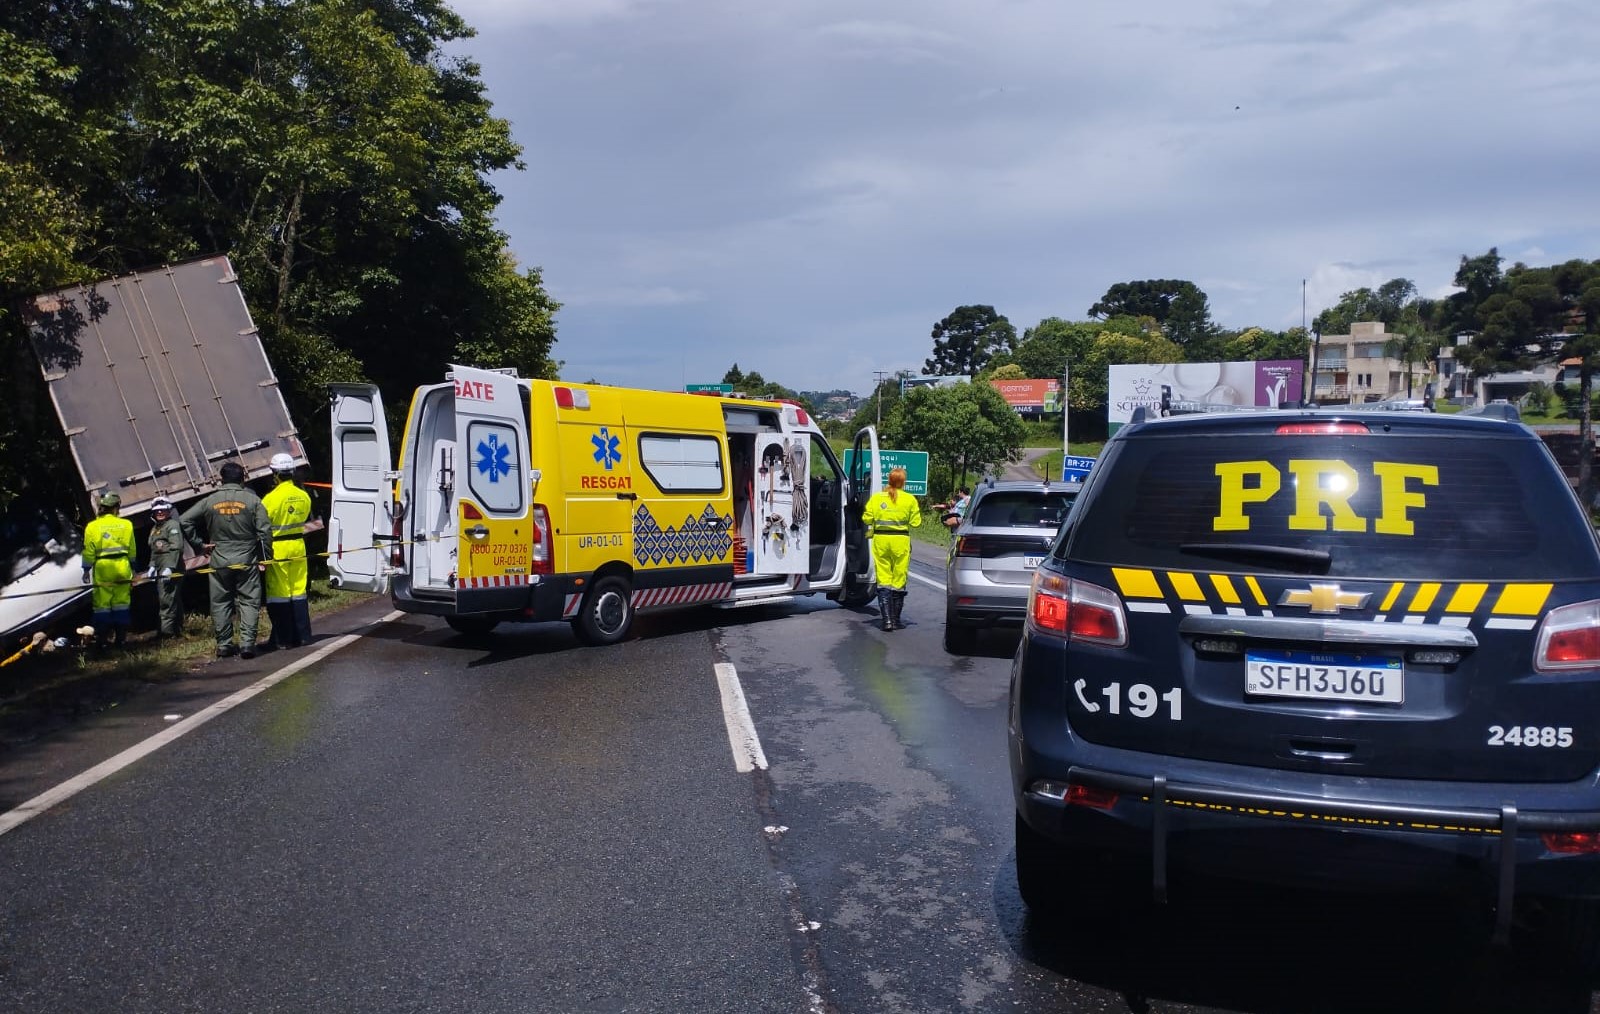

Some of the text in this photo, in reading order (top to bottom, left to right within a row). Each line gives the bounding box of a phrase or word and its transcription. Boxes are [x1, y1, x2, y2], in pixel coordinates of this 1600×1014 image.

[1067, 459, 1095, 468] BR-277
[1213, 459, 1439, 536] PRF
[579, 534, 624, 548] UR-01-01
[493, 544, 507, 554] 277
[509, 544, 528, 554] 0376
[494, 555, 527, 566] UR-01-01
[1311, 654, 1336, 663] BRASIL
[1260, 664, 1385, 697] SFH3J60
[1102, 682, 1182, 721] 191
[1487, 725, 1574, 748] 24885
